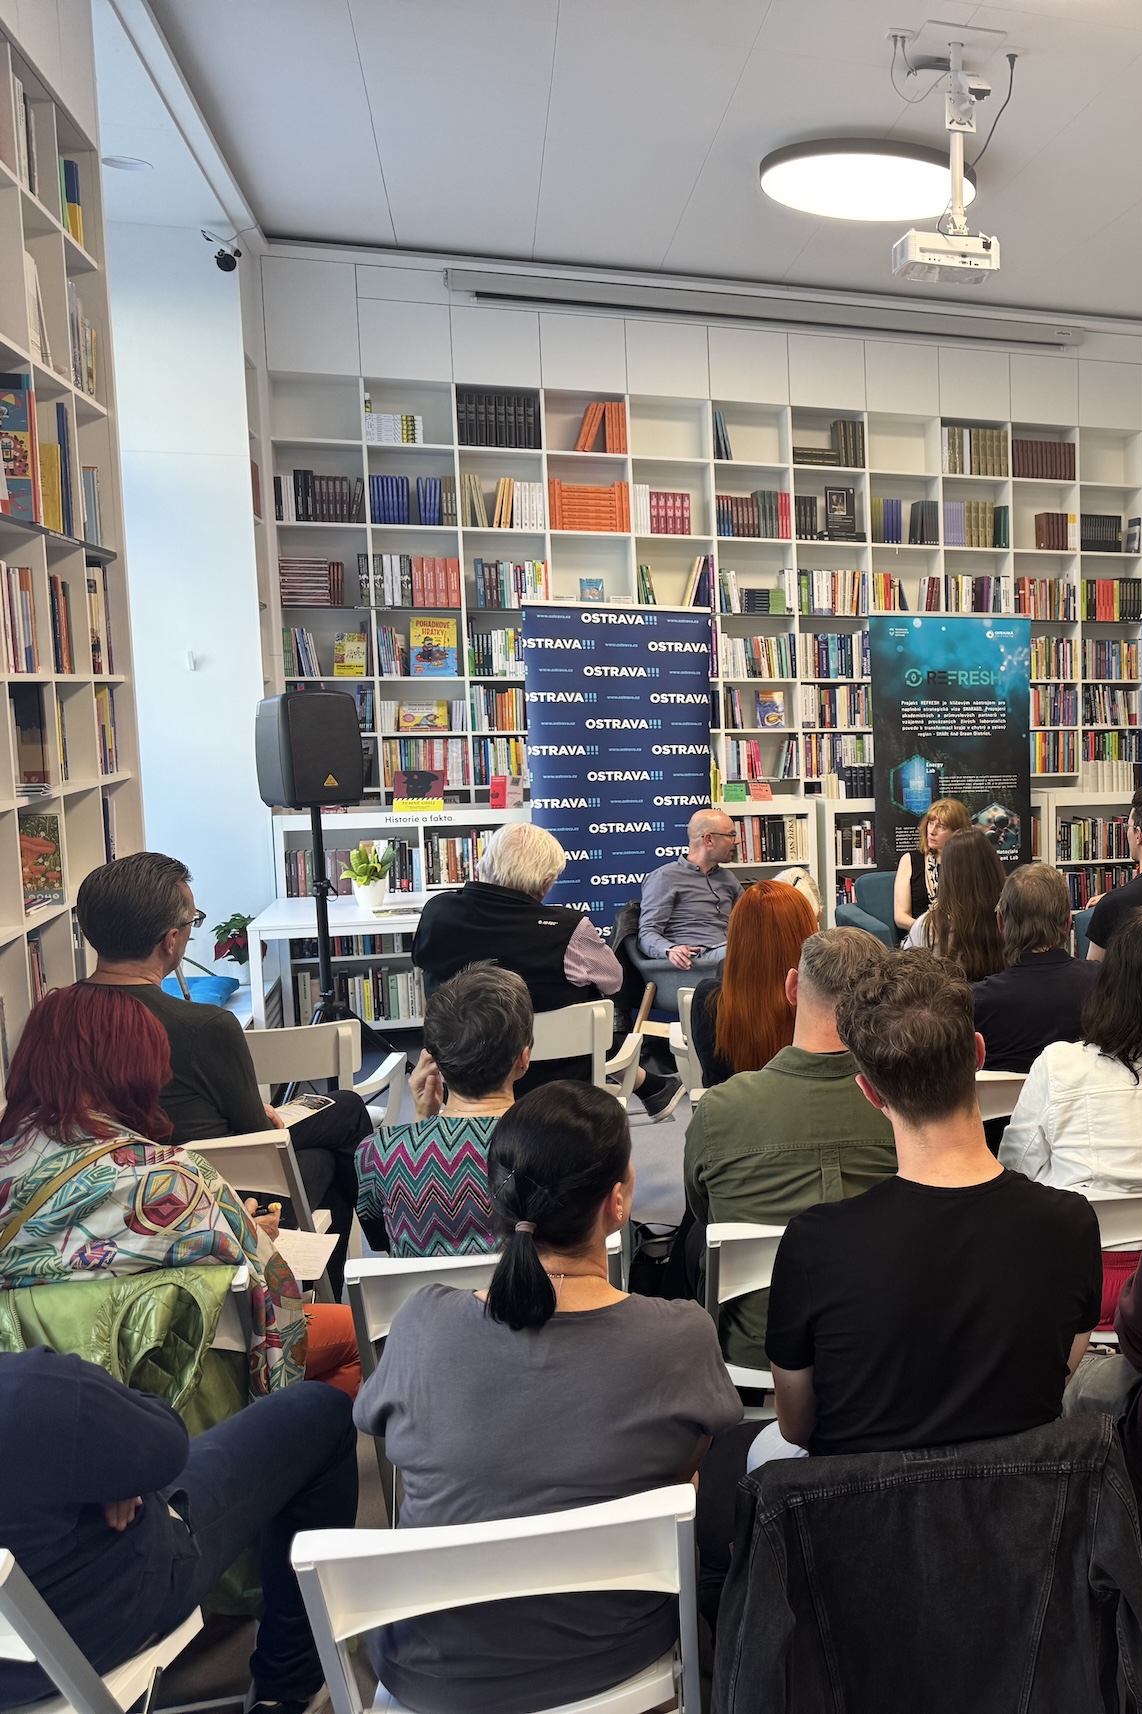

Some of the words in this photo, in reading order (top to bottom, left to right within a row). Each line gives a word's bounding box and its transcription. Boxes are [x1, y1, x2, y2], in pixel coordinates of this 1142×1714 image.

[416, 620, 450, 629] POHÁDKOVÉ
[581, 613, 658, 625] OSTRAVA!!!
[422, 628, 444, 636] HRÁTKY
[584, 666, 659, 678] OSTRAVA!!!
[927, 671, 1001, 685] REFRESH
[586, 719, 662, 730] OSTRAVA!!!
[587, 771, 663, 782] OSTRAVA!!!
[589, 822, 665, 833] OSTRAVA!!!
[564, 850, 602, 861] AVA!!!
